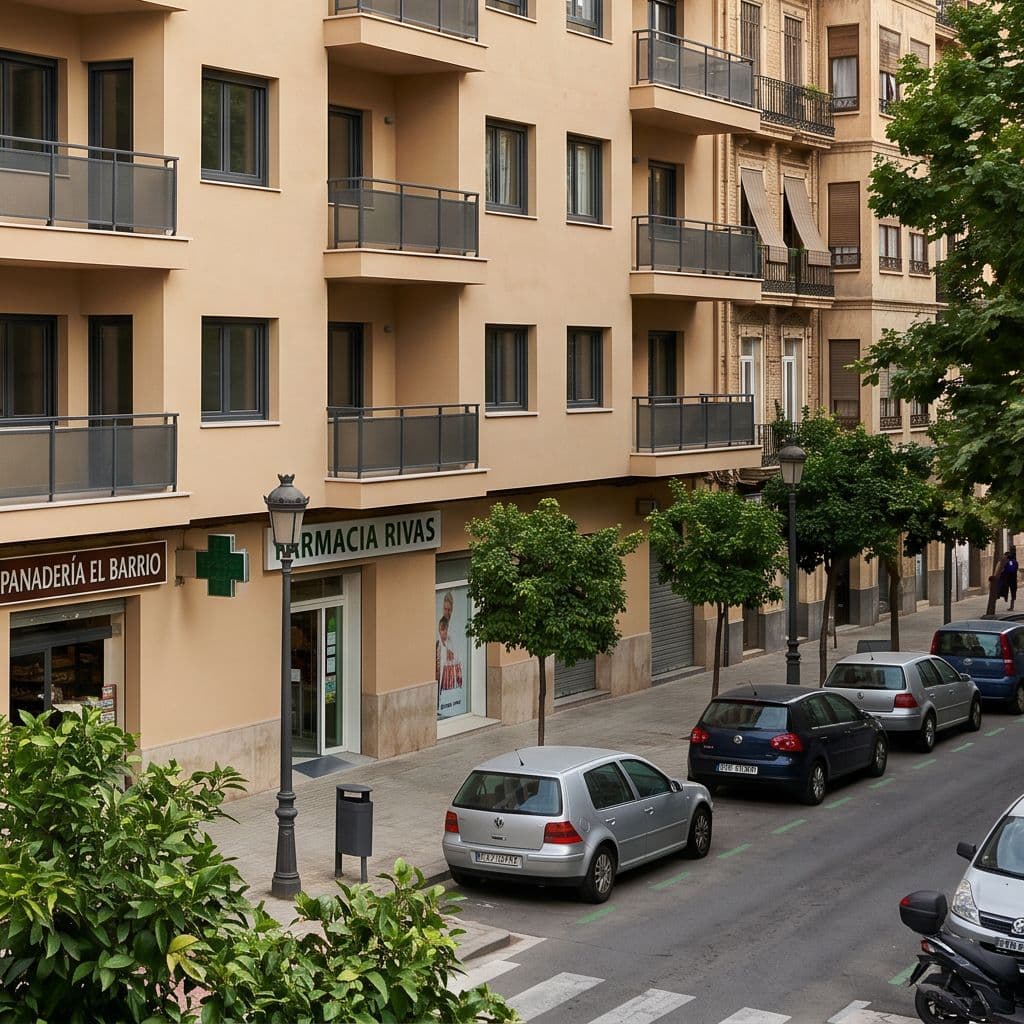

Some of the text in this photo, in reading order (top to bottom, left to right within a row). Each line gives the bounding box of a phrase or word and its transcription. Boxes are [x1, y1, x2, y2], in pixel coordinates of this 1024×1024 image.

[385, 517, 435, 548] RIVAS
[0, 552, 161, 595] PANADERÍA EL BARRIO
